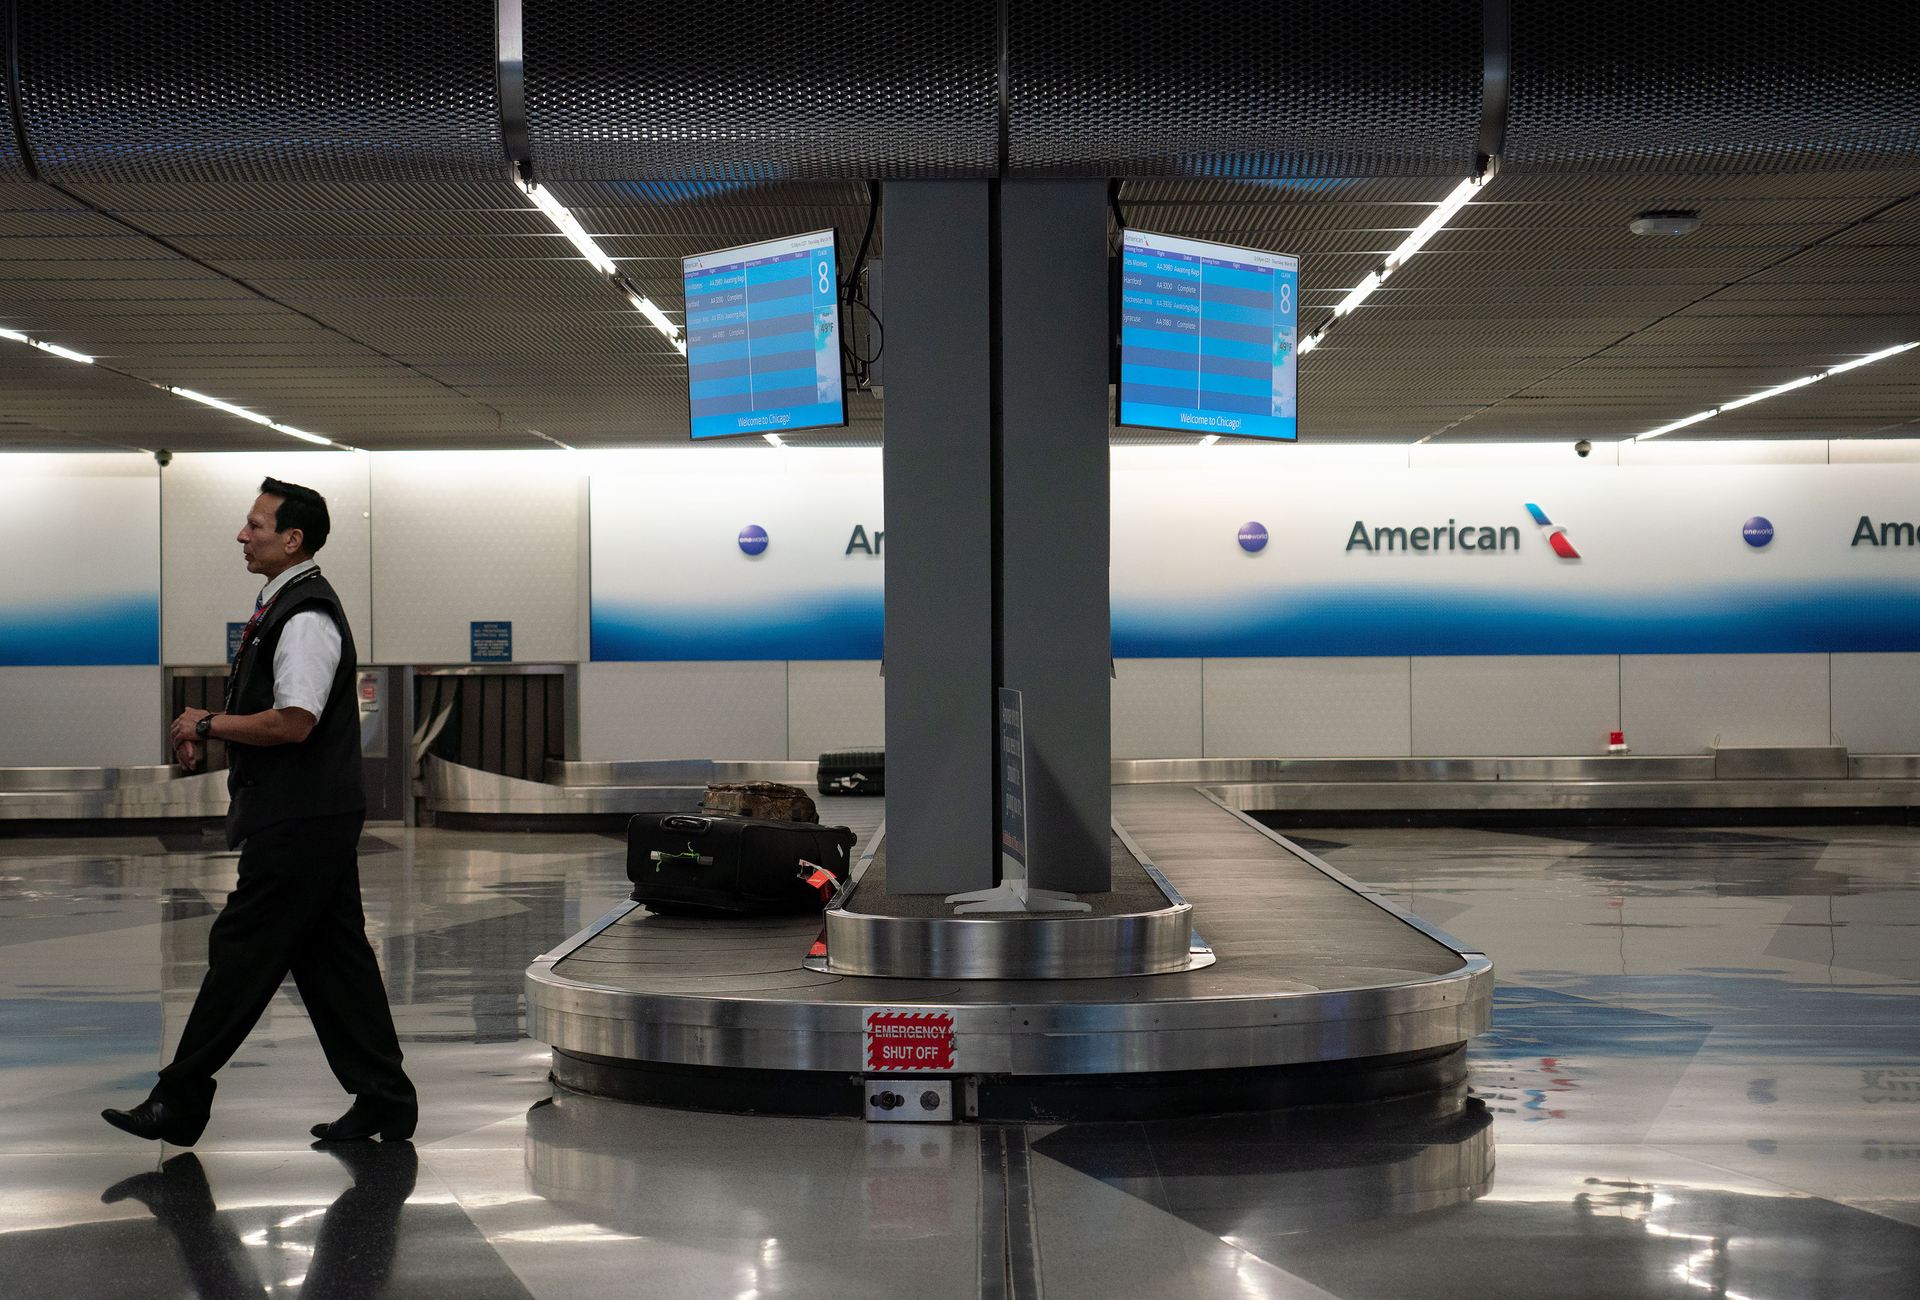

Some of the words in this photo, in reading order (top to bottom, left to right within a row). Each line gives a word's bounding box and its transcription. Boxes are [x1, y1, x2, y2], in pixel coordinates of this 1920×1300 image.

[1125, 235, 1143, 243] American
[1133, 259, 1148, 267] Moines
[1174, 266, 1190, 276] Awaiting
[1191, 268, 1199, 277] Bags
[818, 261, 829, 293] 8
[1124, 276, 1141, 286] Hartford
[1177, 284, 1196, 294] Complete
[727, 293, 743, 302] Complete
[1281, 284, 1290, 314] 8
[1174, 302, 1190, 312] Awaiting
[1123, 314, 1141, 323] Syracuse
[1177, 320, 1196, 330] Complete
[738, 416, 761, 427] Welcome
[762, 416, 768, 424] to
[769, 412, 791, 426] Chicago!
[1180, 413, 1208, 425] Welcome
[1209, 417, 1215, 425] to
[1217, 416, 1241, 430] Chicago!
[1345, 519, 1520, 551] American
[875, 1025, 946, 1039] EMERGENCY
[883, 1046, 913, 1059] SHUT
[916, 1046, 938, 1059] OFF
